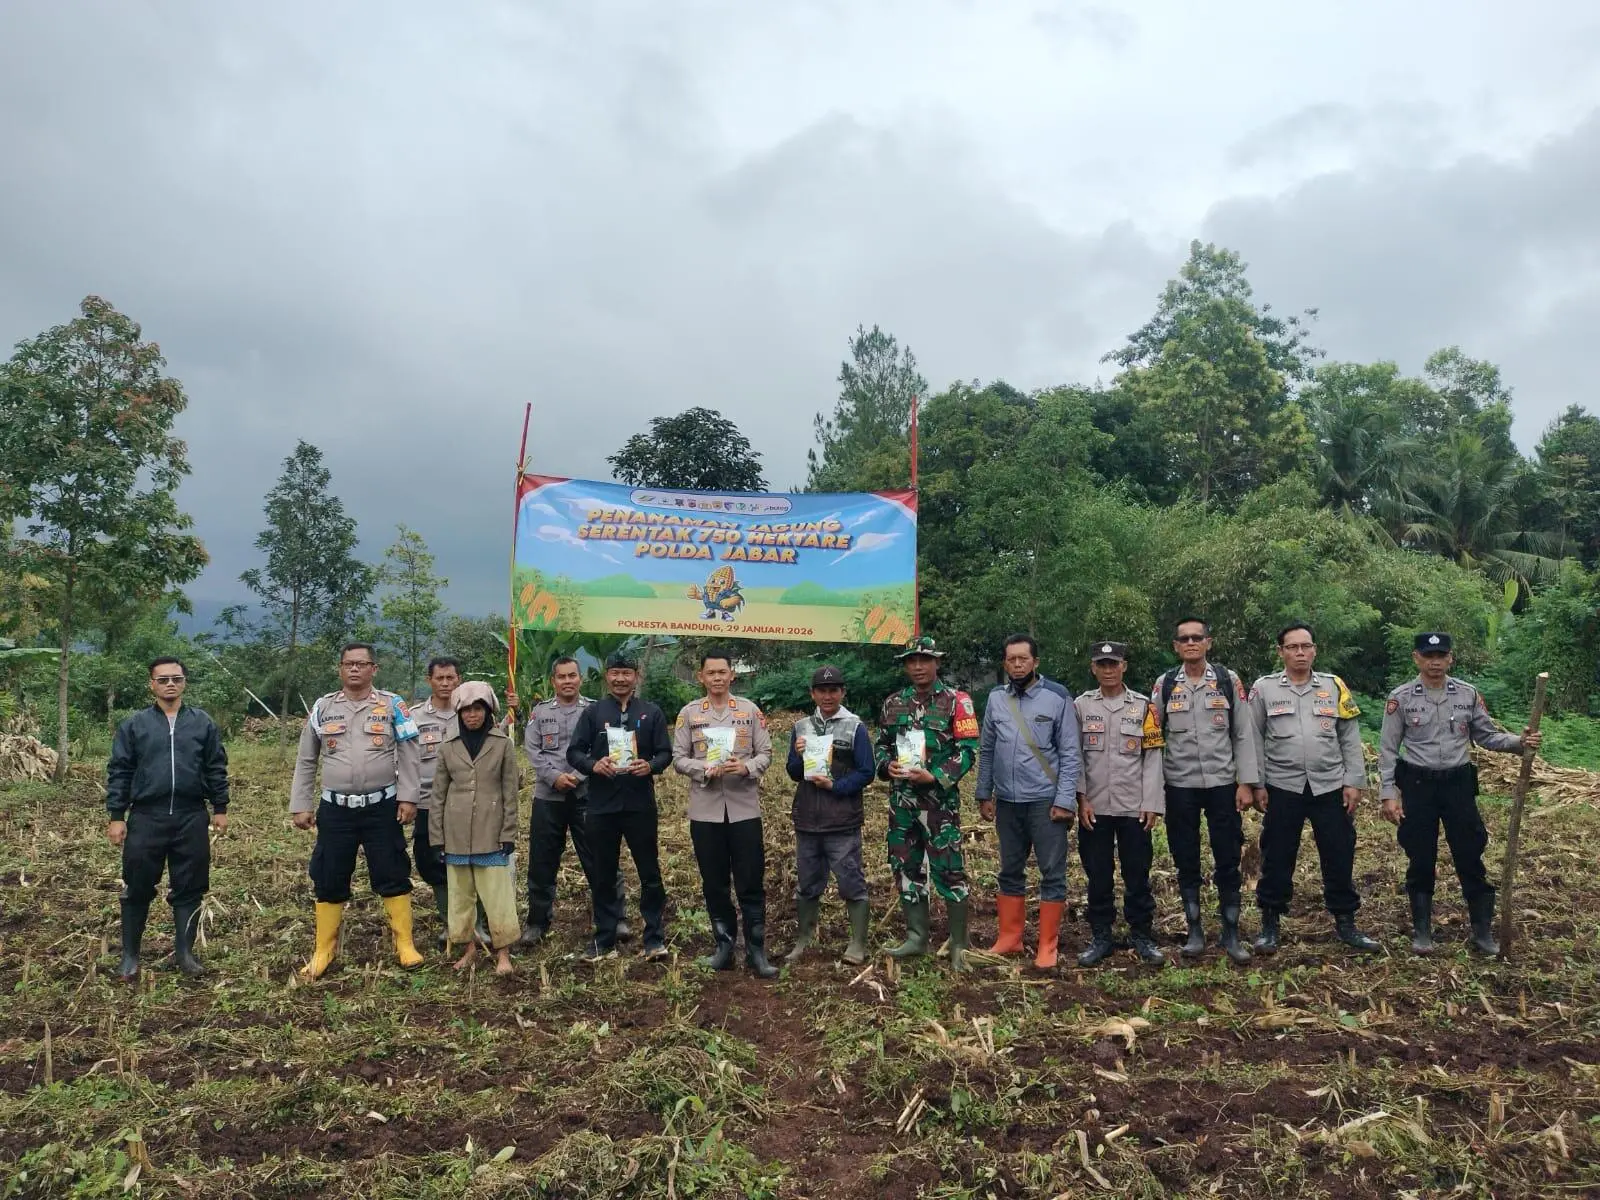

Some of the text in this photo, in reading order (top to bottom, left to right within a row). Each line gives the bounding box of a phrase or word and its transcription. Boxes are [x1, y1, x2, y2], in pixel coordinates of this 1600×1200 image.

[746, 520, 843, 533] JAGUNG
[578, 523, 852, 550] SERENTAK 750 HEKTARE
[635, 541, 797, 564] POLDA JABAR
[618, 620, 814, 636] POLRESTA BANDUNG, 29 JANUARI 2026
[367, 715, 391, 723] POLRI
